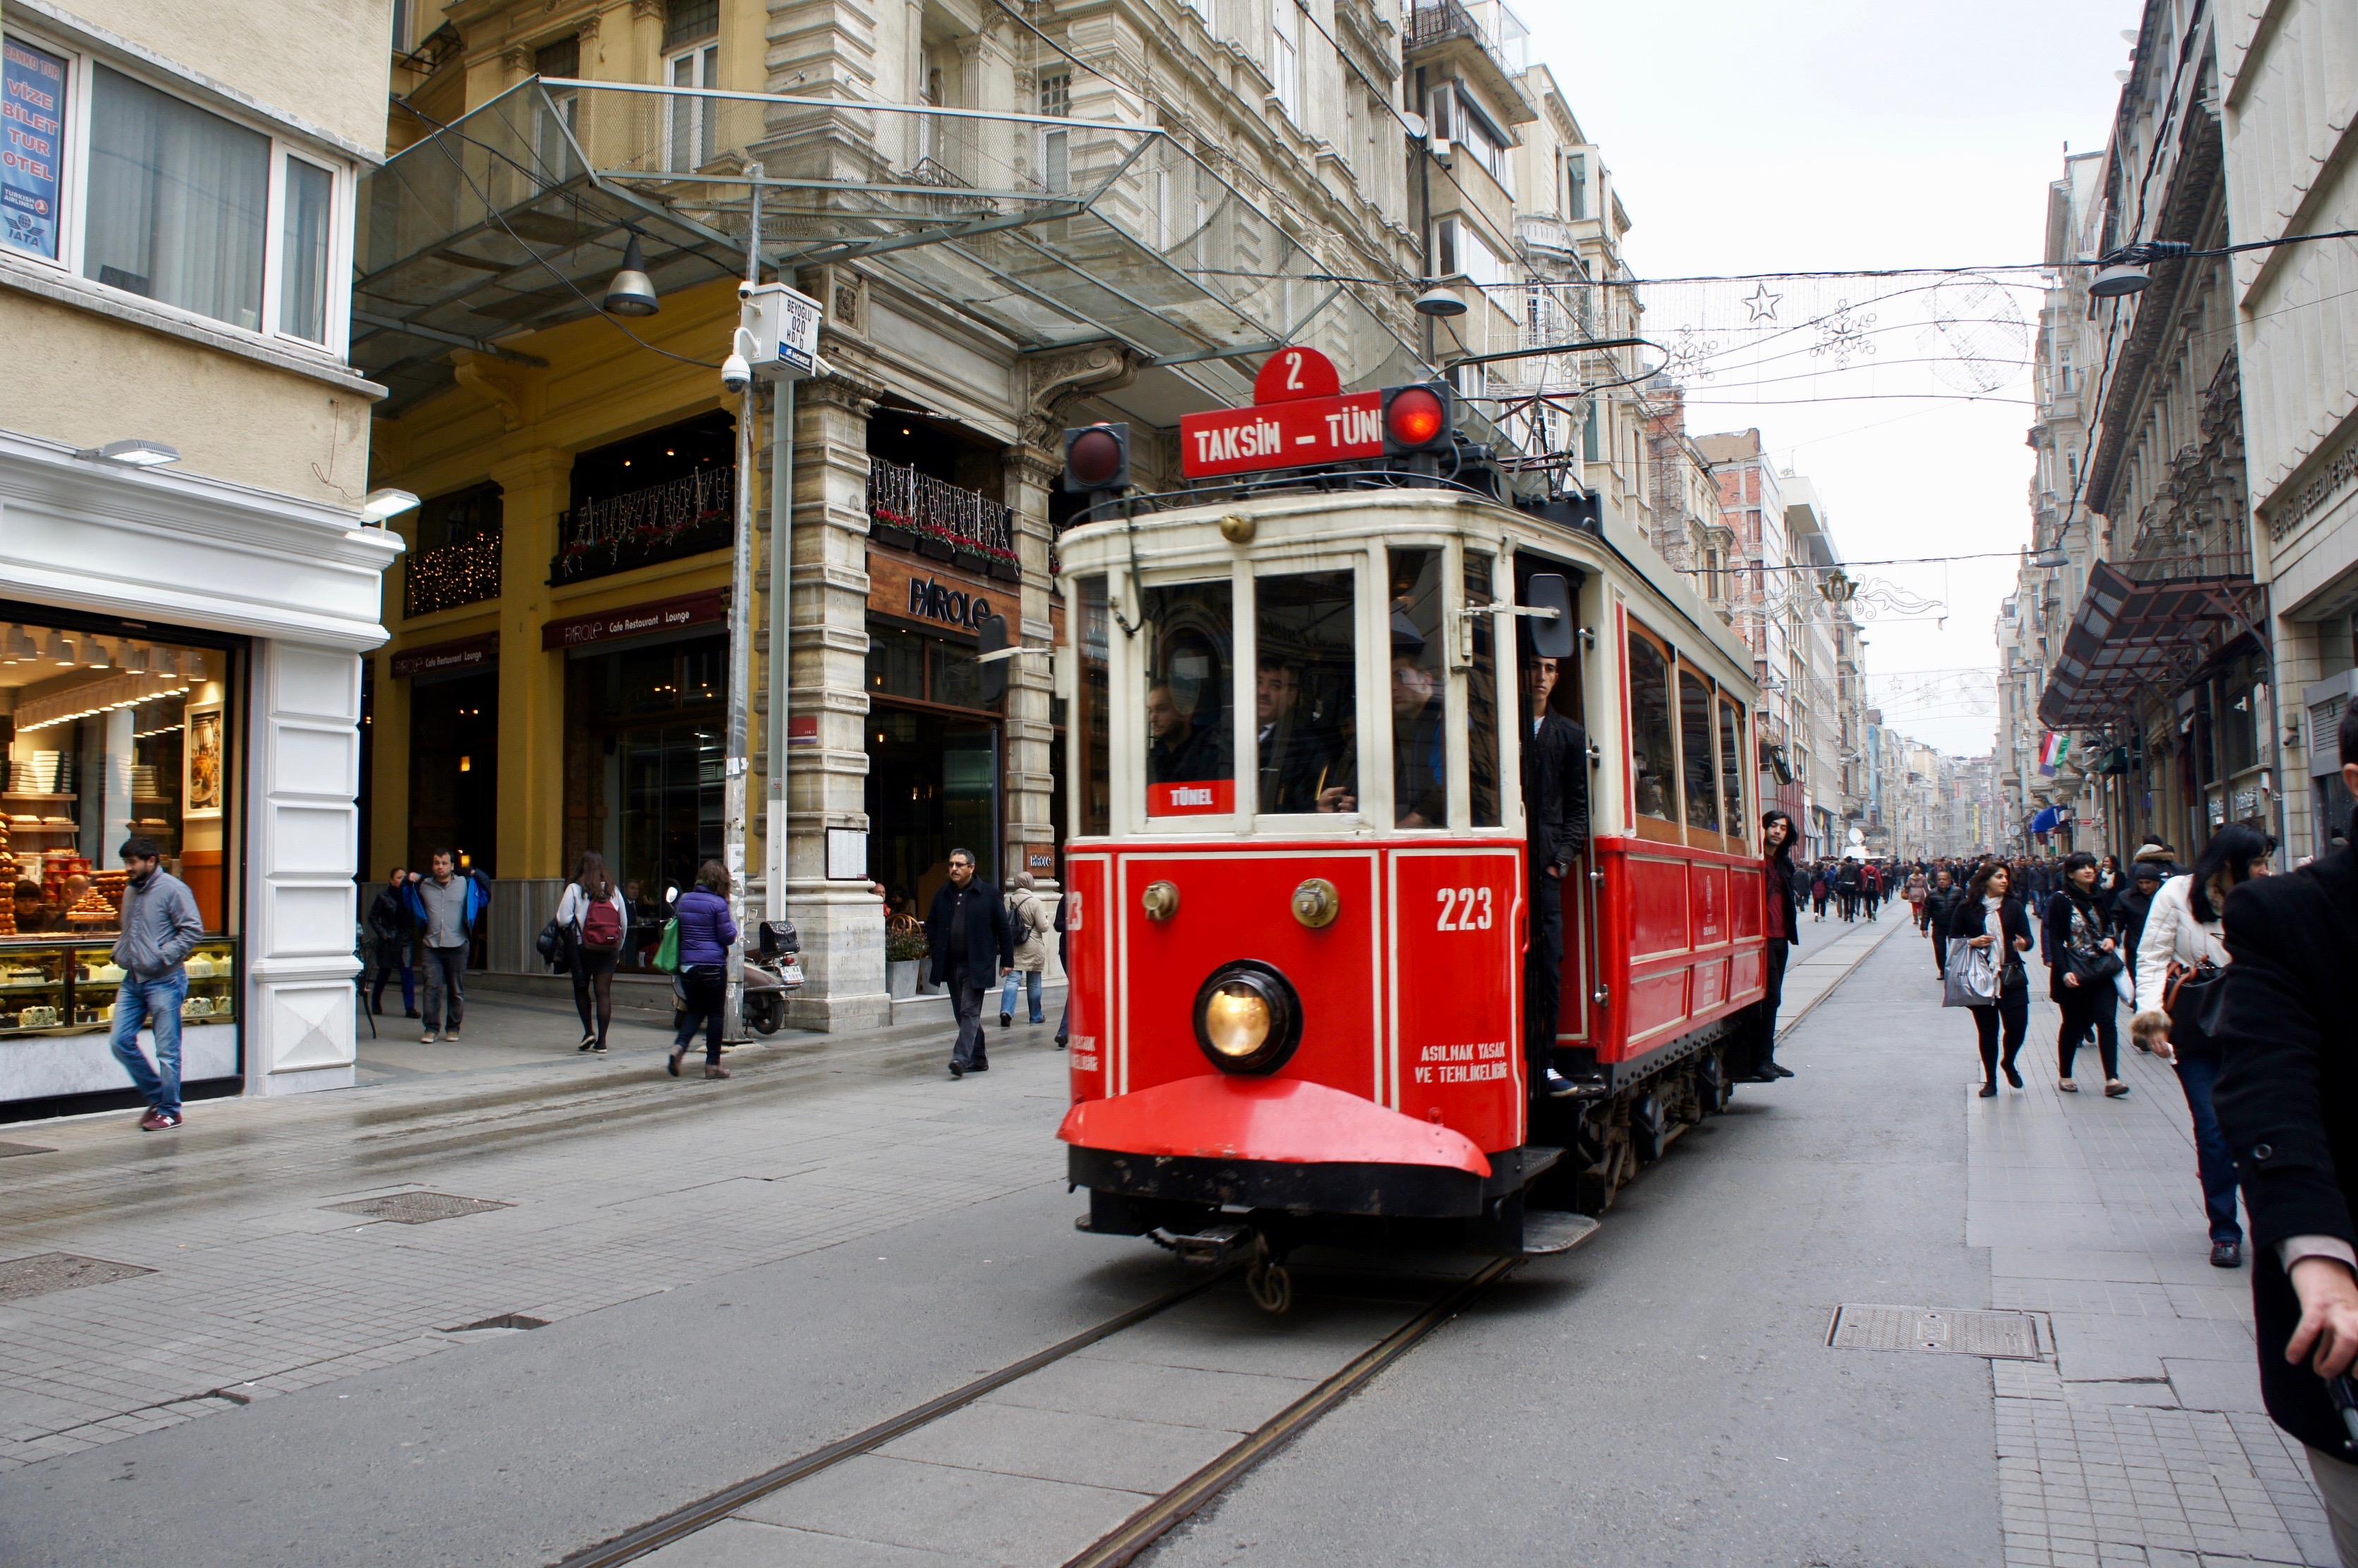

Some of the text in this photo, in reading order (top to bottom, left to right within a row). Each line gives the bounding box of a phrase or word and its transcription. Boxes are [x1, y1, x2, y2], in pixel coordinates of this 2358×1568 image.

[4, 44, 60, 81] BANKO TUR
[7, 78, 53, 111] VİZE
[1, 99, 58, 134] BİLET
[8, 127, 50, 157] TUR
[3, 150, 53, 182] OTEL
[4, 188, 35, 204] TURKISH
[4, 195, 35, 209] AIRLINES
[8, 229, 39, 247] IATA
[787, 299, 812, 322] BEYOĞLU
[792, 315, 806, 335] 020
[1285, 352, 1304, 390] 2
[1194, 417, 1281, 463] TAKSİM
[609, 621, 623, 633] Cafe
[625, 615, 659, 631] Restaurant
[665, 611, 690, 623] Lounge
[425, 658, 436, 668] Cafe
[436, 653, 462, 666] Restaurant
[464, 651, 482, 662] Lounge
[1170, 786, 1214, 806] TÜNEL
[1437, 887, 1492, 931] 223
[1421, 1041, 1505, 1061] ASILMAK YASAK
[1415, 1067, 1433, 1083] VE
